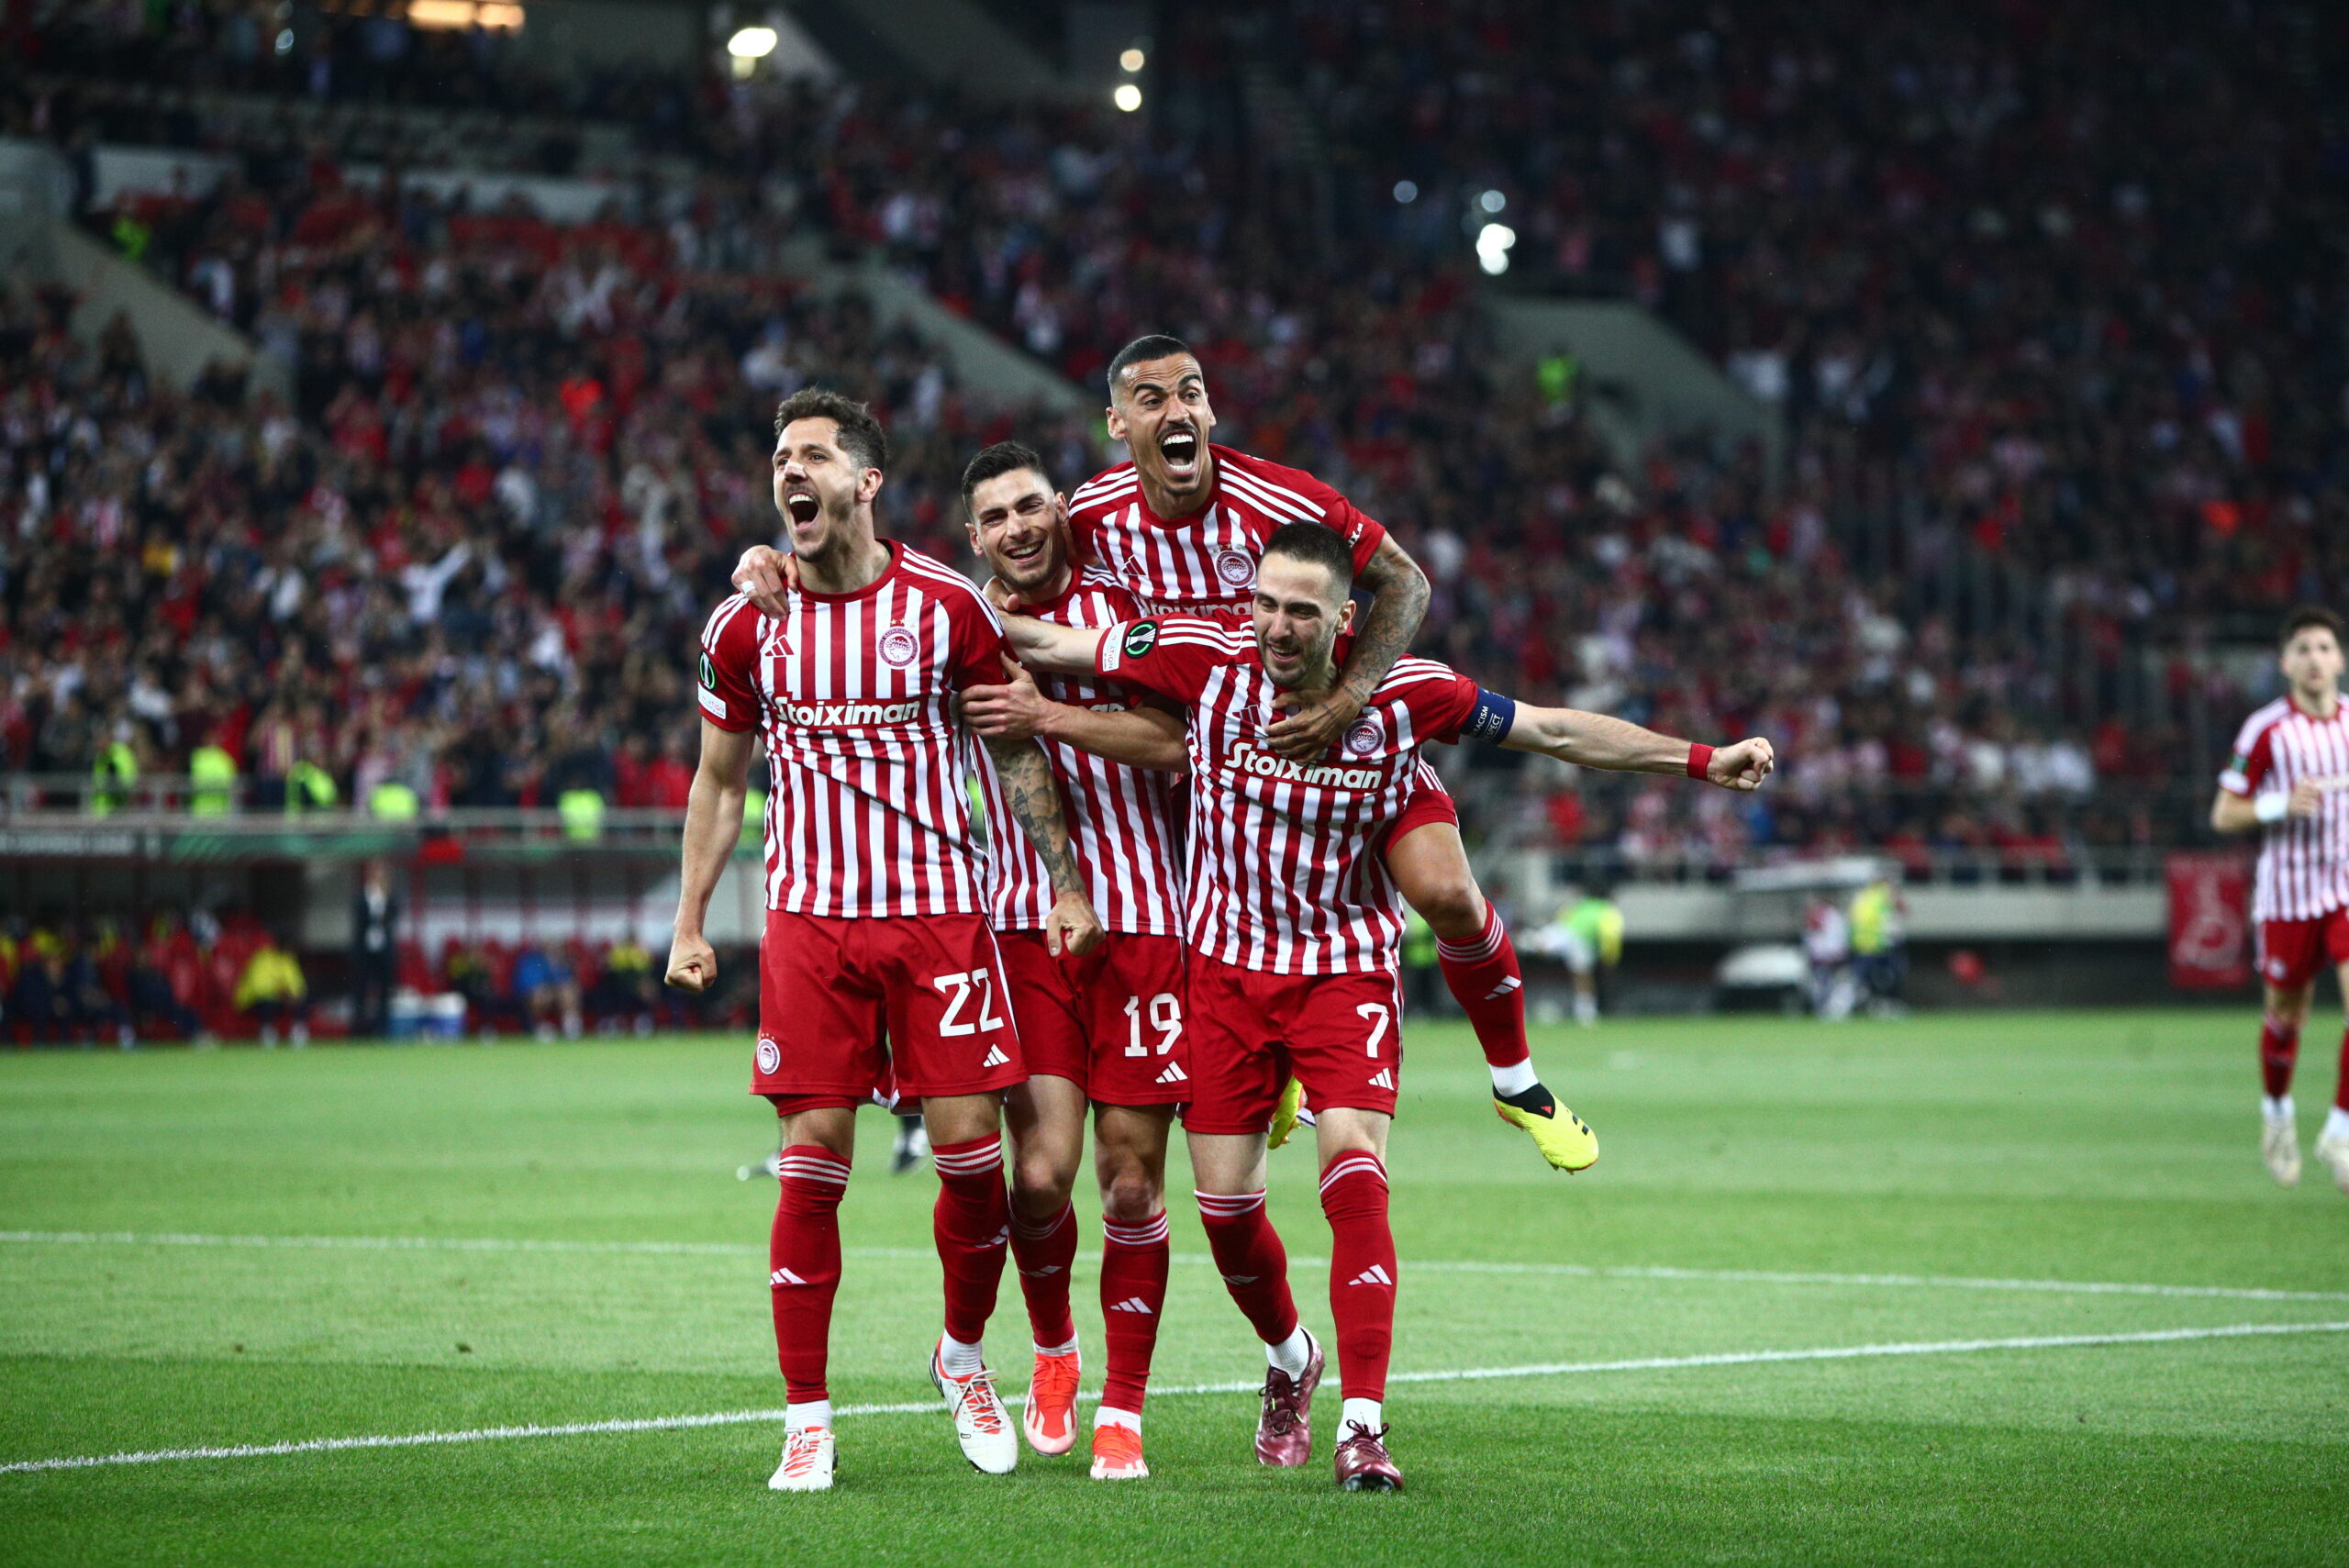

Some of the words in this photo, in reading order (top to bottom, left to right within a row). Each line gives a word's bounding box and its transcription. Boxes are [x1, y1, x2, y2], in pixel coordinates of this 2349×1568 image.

[773, 696, 920, 727] Stoiximan
[1224, 741, 1383, 789] Stoiximan
[934, 967, 1004, 1037] 22
[1124, 993, 1181, 1058] 19
[1356, 1003, 1389, 1058] 7
